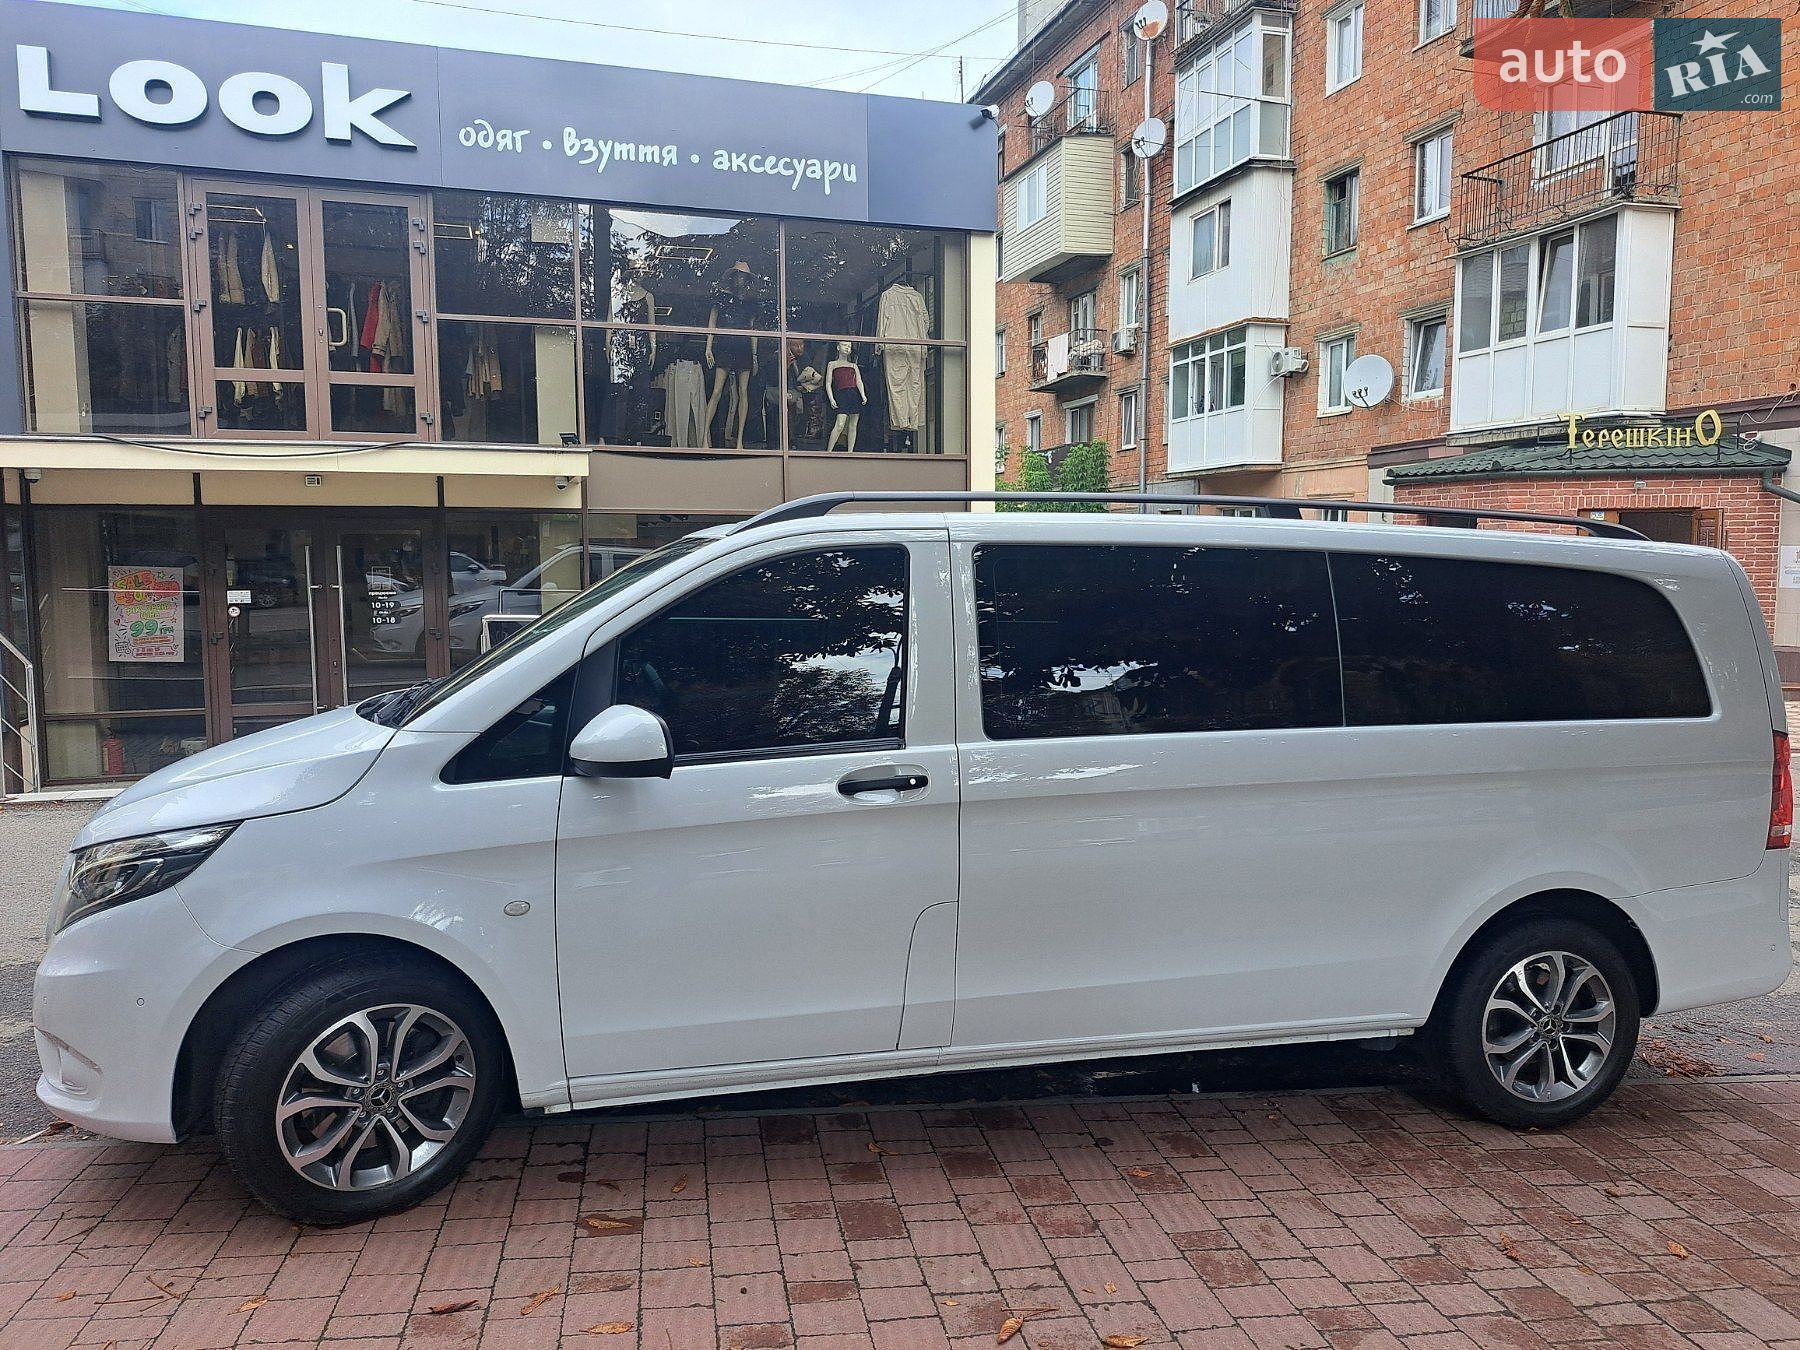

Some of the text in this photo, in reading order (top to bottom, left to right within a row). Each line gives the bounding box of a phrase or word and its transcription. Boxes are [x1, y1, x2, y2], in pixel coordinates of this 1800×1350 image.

[459, 119, 858, 195] одяг взуття аксесуари
[130, 619, 158, 638] 99
